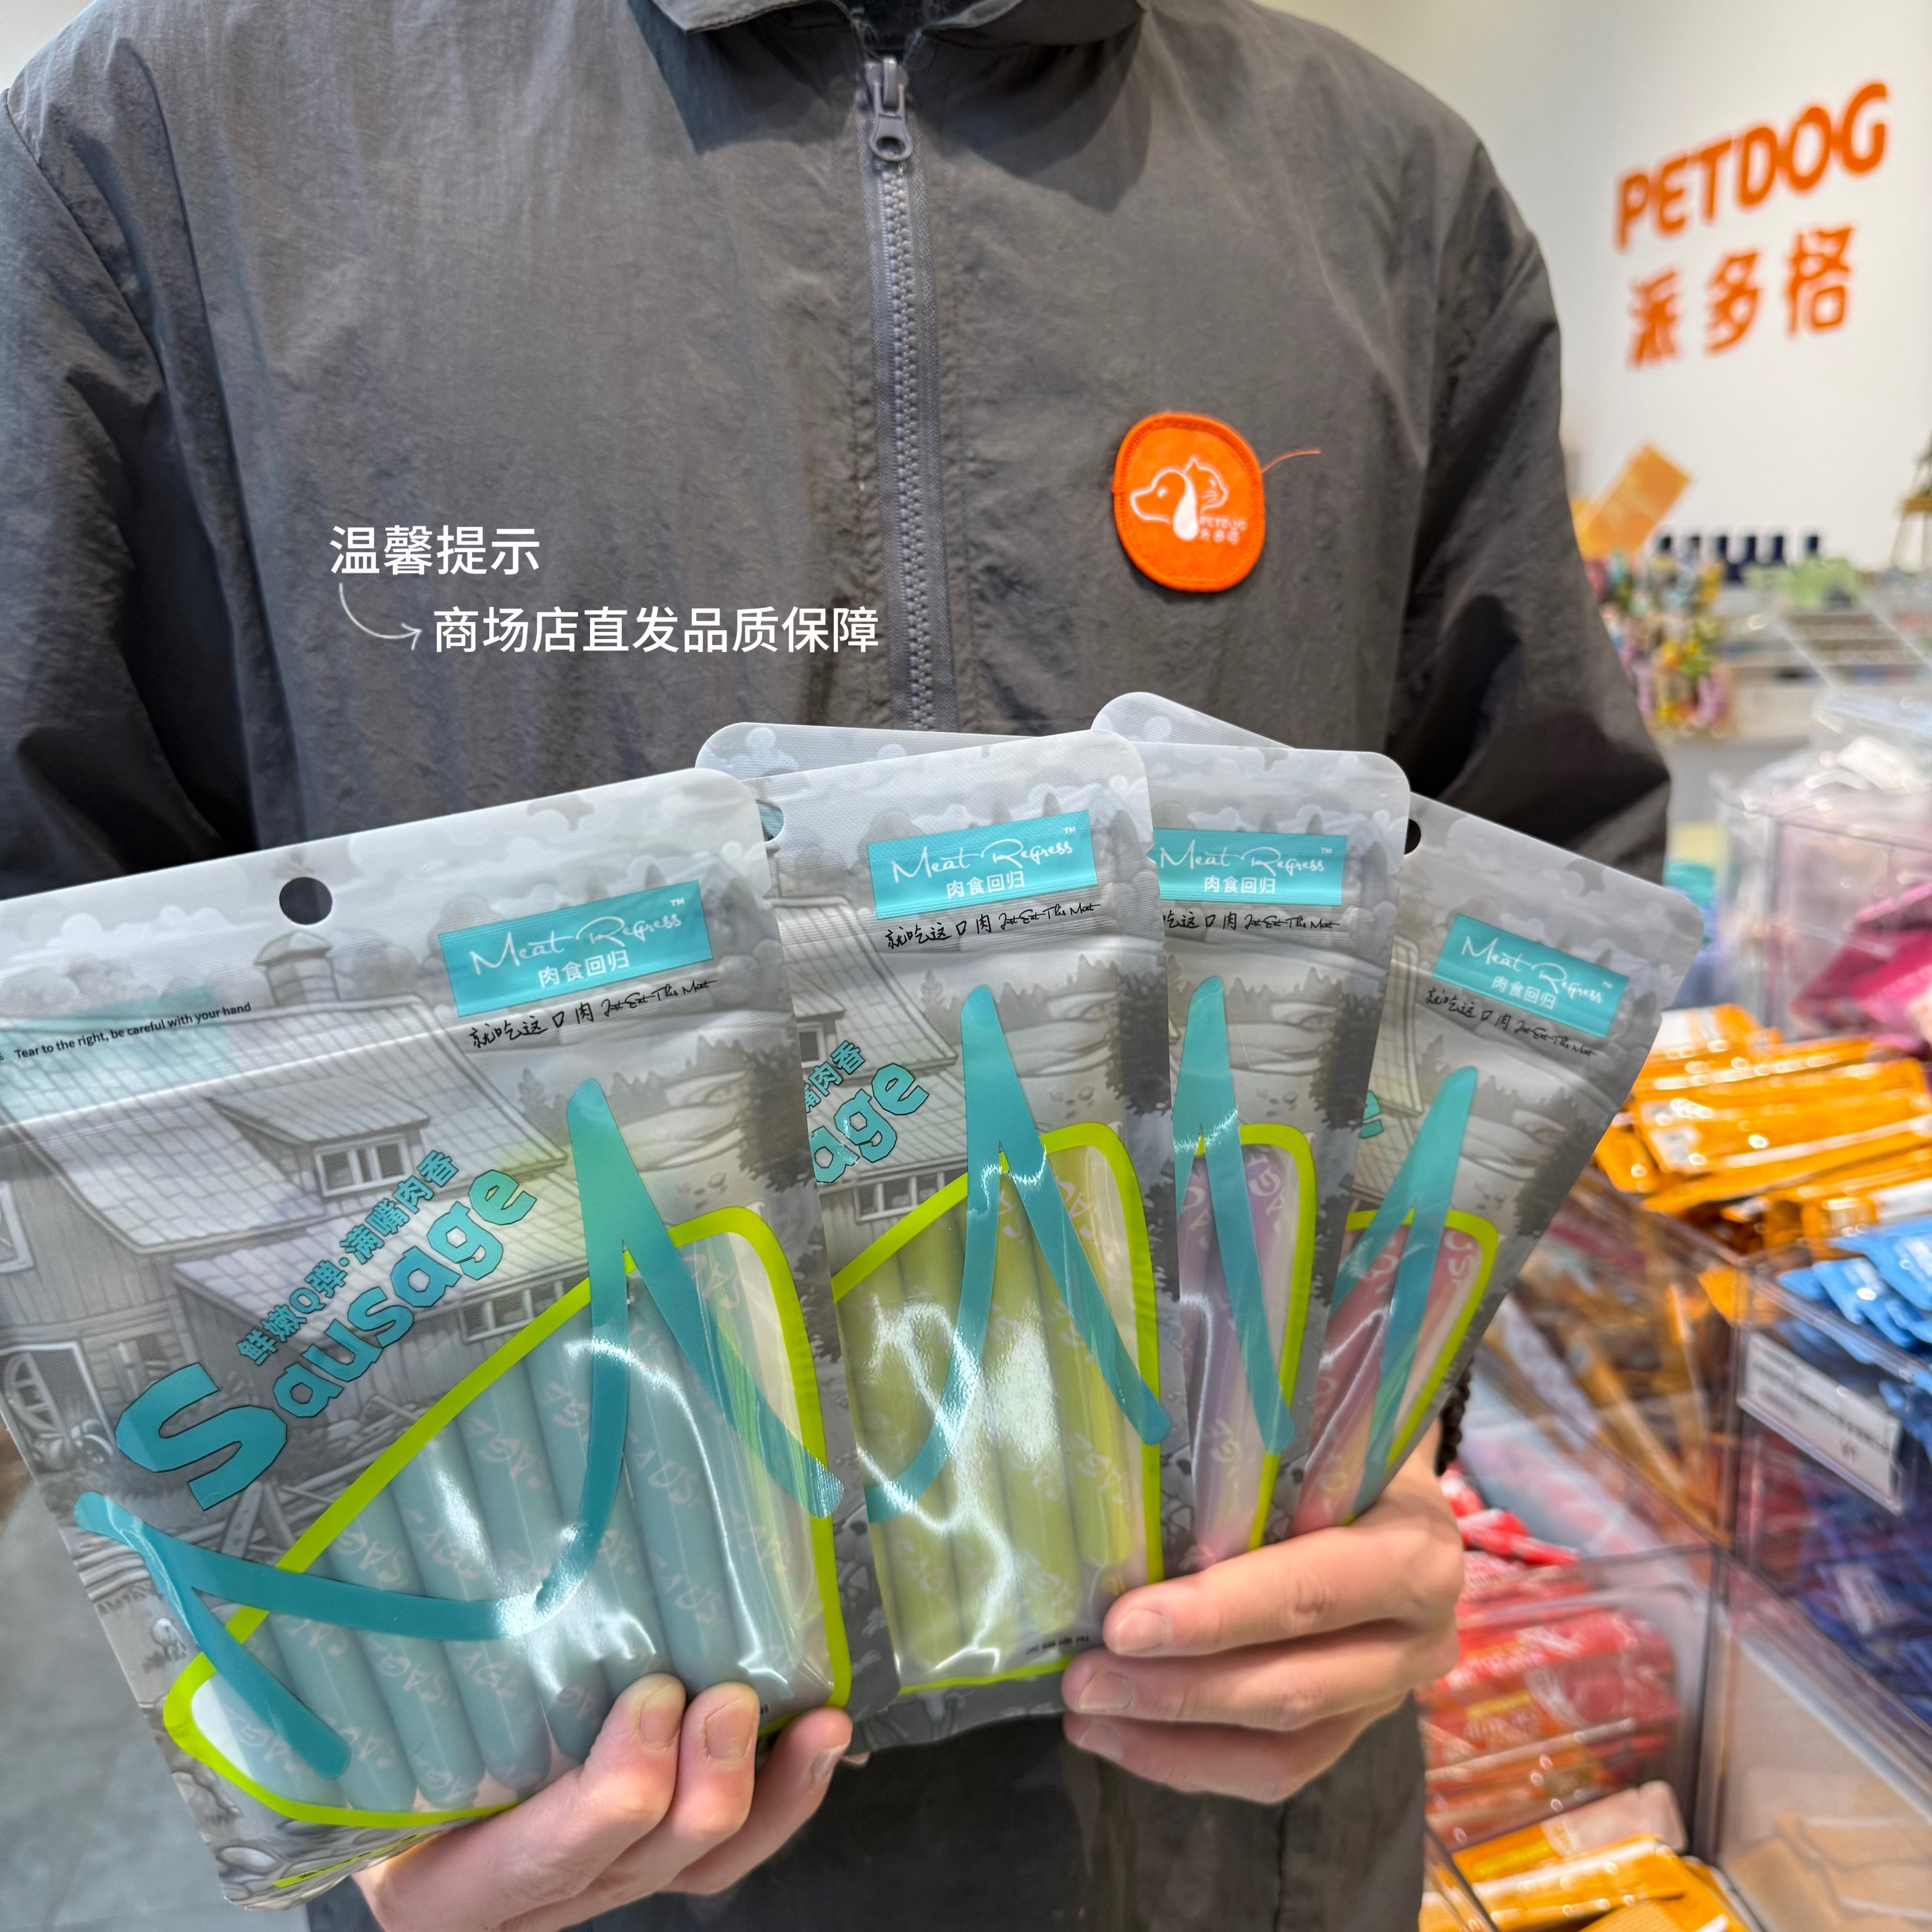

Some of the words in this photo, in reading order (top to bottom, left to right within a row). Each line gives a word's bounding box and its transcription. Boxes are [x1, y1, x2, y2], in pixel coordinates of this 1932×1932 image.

[1615, 80, 1889, 251] PETDOG
[891, 845, 980, 883] Meat
[980, 838, 1073, 869] Regress
[1160, 839, 1241, 870] Meat
[1241, 847, 1324, 876] Regress
[946, 871, 1025, 899] 肉食回归
[1204, 876, 1276, 895] 肉食回归
[469, 931, 573, 975] Meat
[576, 914, 682, 947] Regress
[538, 949, 630, 988] 肉食回归
[1461, 936, 1532, 972] Meat
[1532, 962, 1602, 1003] Regress
[1491, 975, 1556, 1010] 肉食回归
[14, 1047, 39, 1059] Tear
[42, 1044, 54, 1054] to
[56, 1039, 75, 1051] the
[78, 1033, 109, 1047] right,
[110, 1029, 125, 1039] be
[127, 1019, 166, 1036] careful
[168, 1014, 193, 1028] with
[194, 1009, 220, 1024] your
[223, 1002, 251, 1016] hand
[115, 1169, 538, 1511] Sausage
